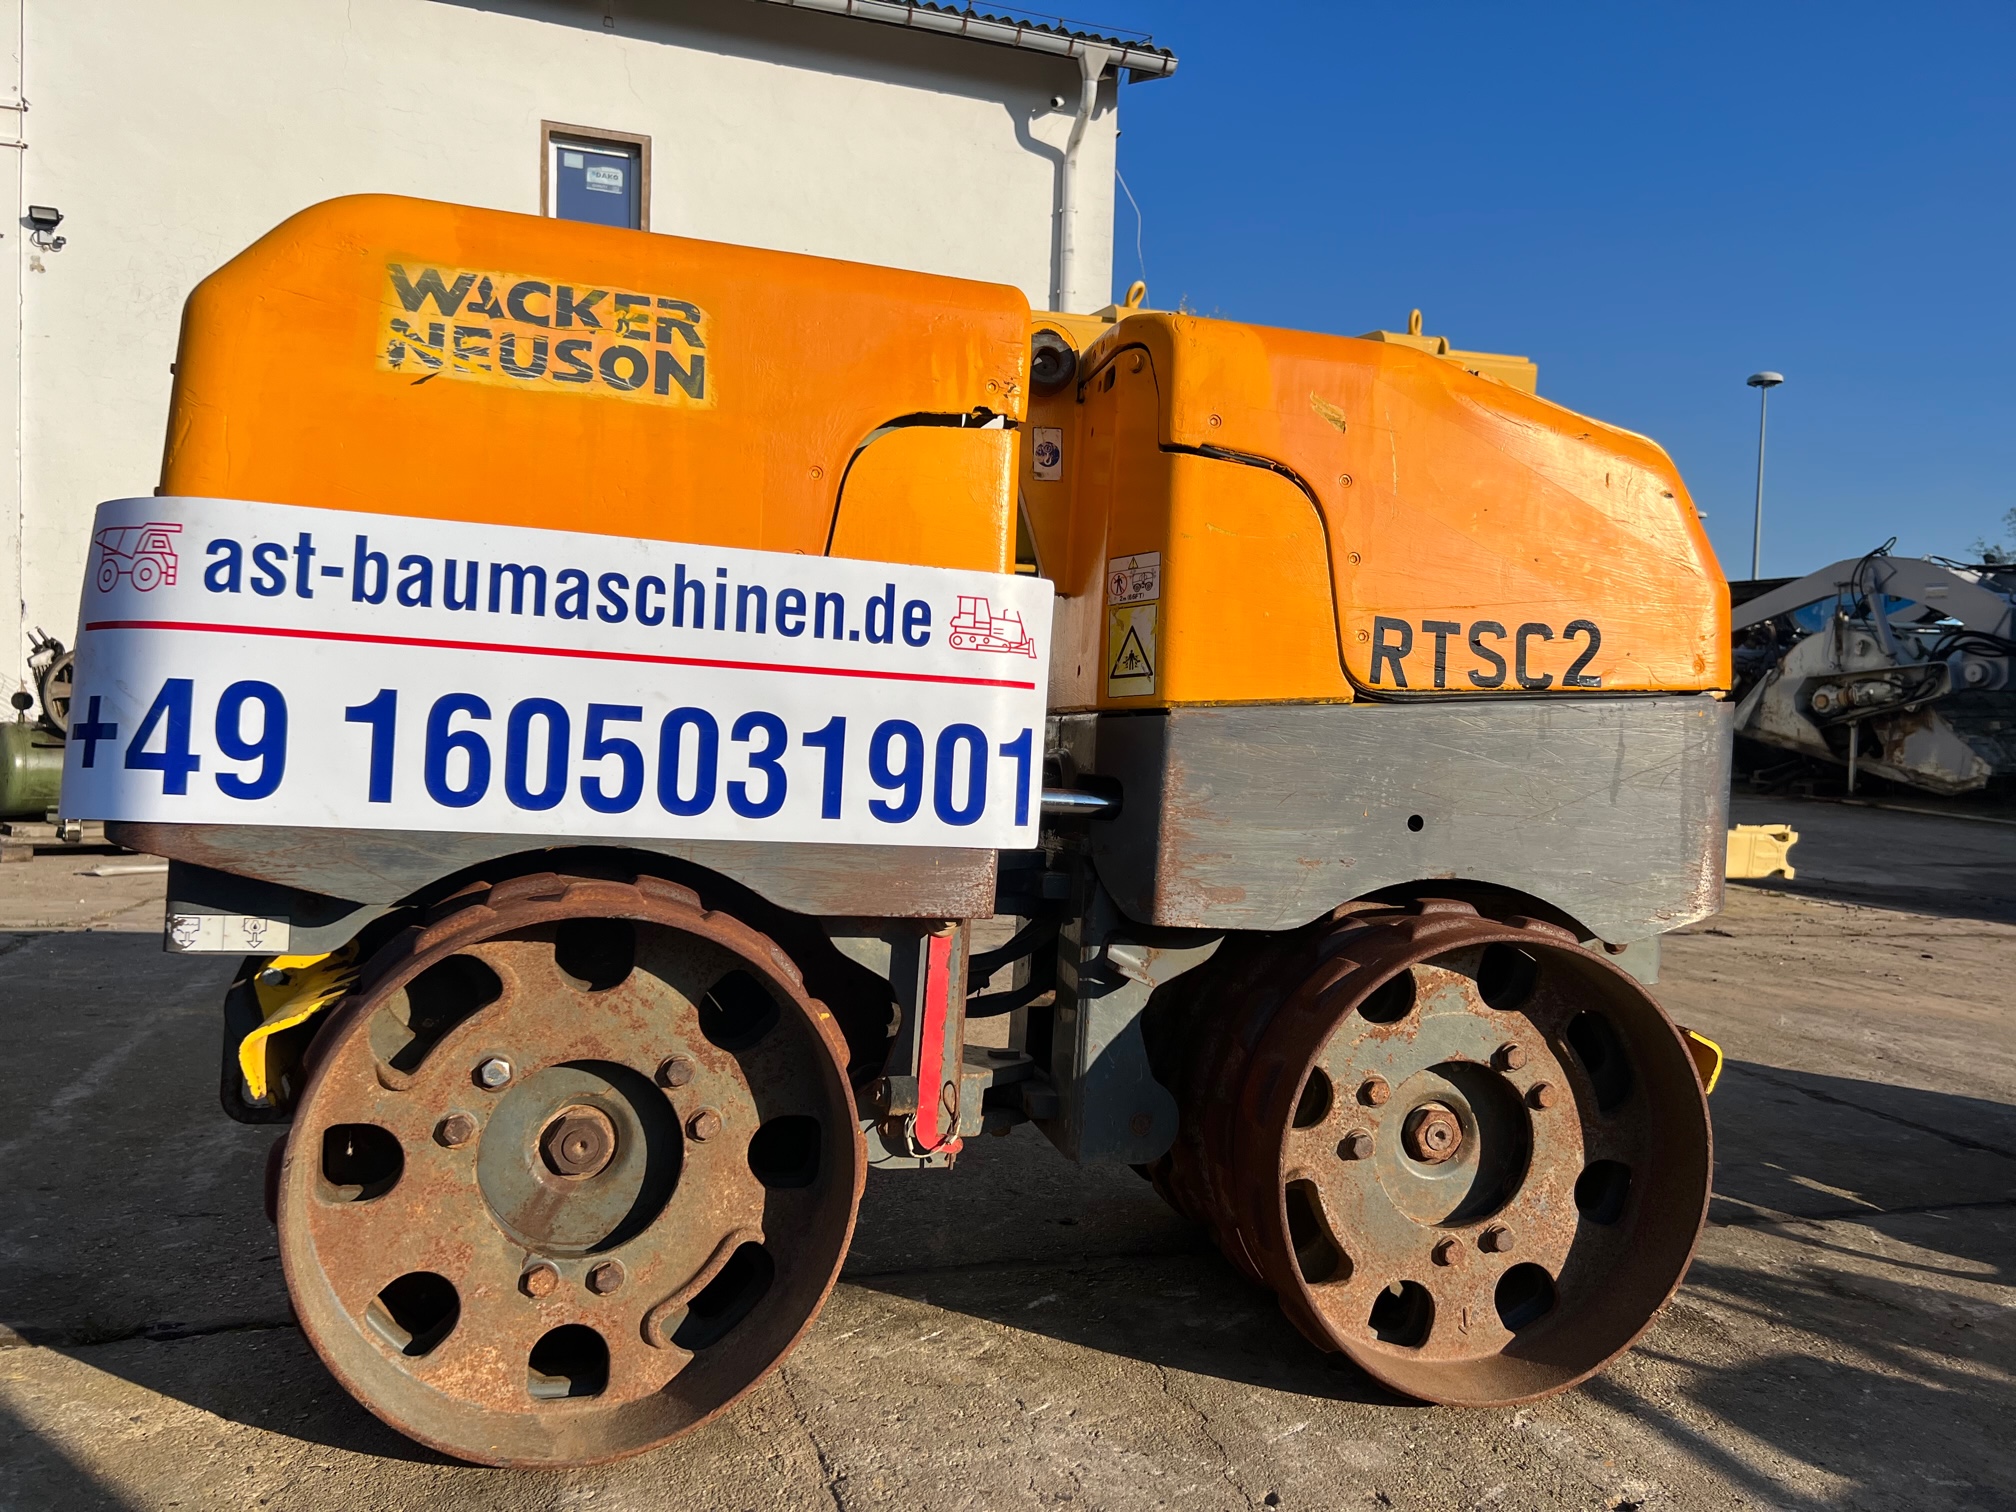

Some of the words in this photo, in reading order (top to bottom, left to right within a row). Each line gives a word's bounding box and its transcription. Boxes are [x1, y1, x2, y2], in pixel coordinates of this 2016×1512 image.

[386, 263, 706, 349] WACKER
[387, 318, 706, 400] NEUSON
[203, 532, 932, 648] ast-baumaschinen.de
[1369, 615, 1602, 690] RTSC2
[72, 677, 288, 800] +49
[344, 688, 1033, 827] 1605031901
